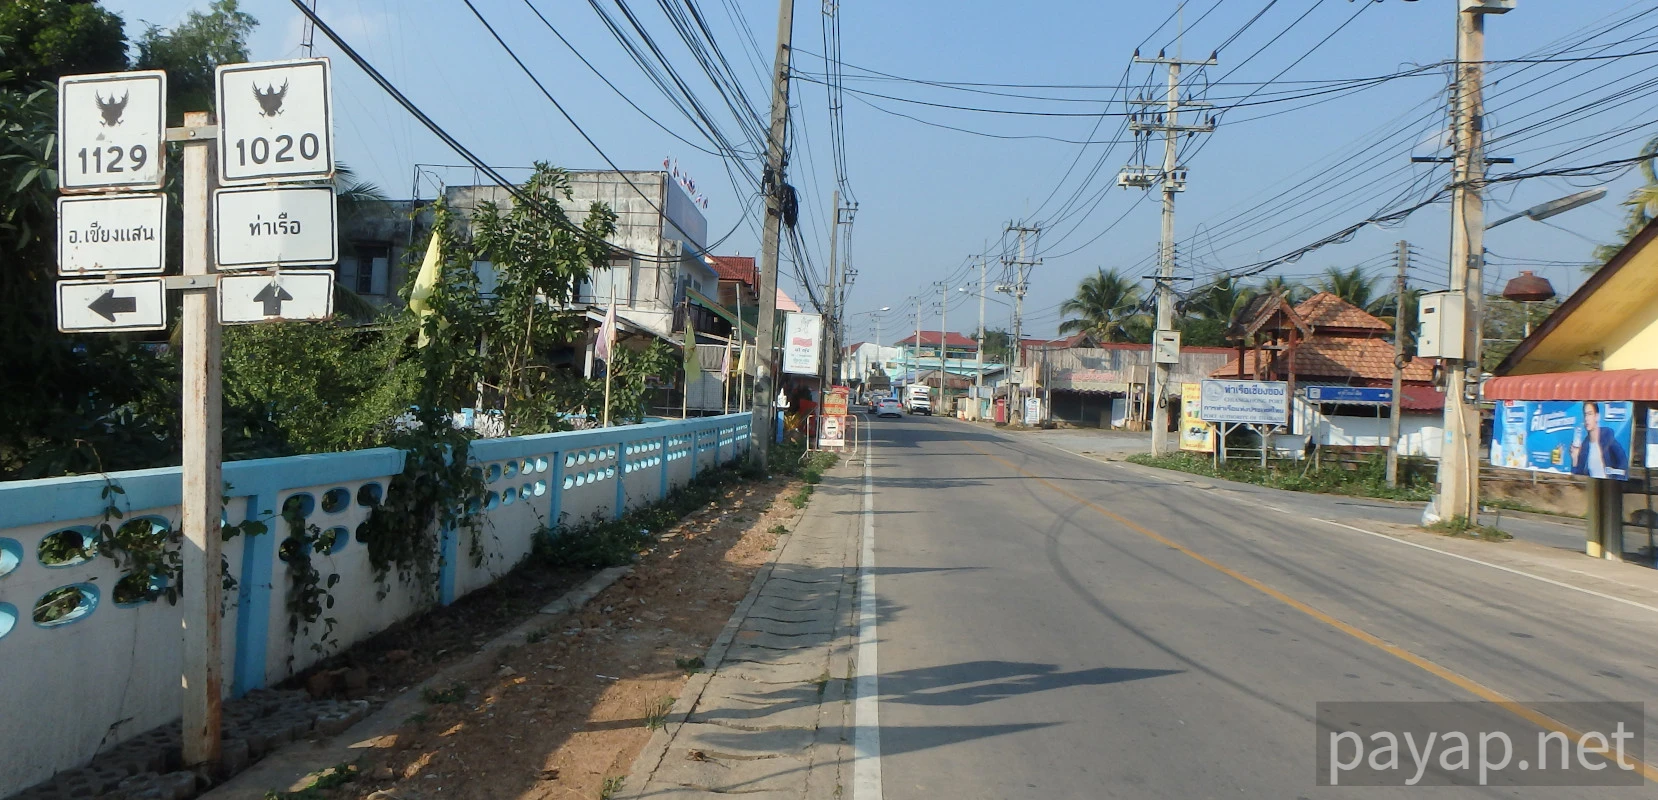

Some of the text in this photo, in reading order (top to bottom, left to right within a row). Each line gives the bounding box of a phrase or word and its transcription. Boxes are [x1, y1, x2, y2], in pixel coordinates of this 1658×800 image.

[78, 144, 148, 175] 1129
[236, 132, 320, 166] 1020
[68, 221, 155, 244] อ.เชียงแสน
[249, 212, 301, 236] ท่าเรือ
